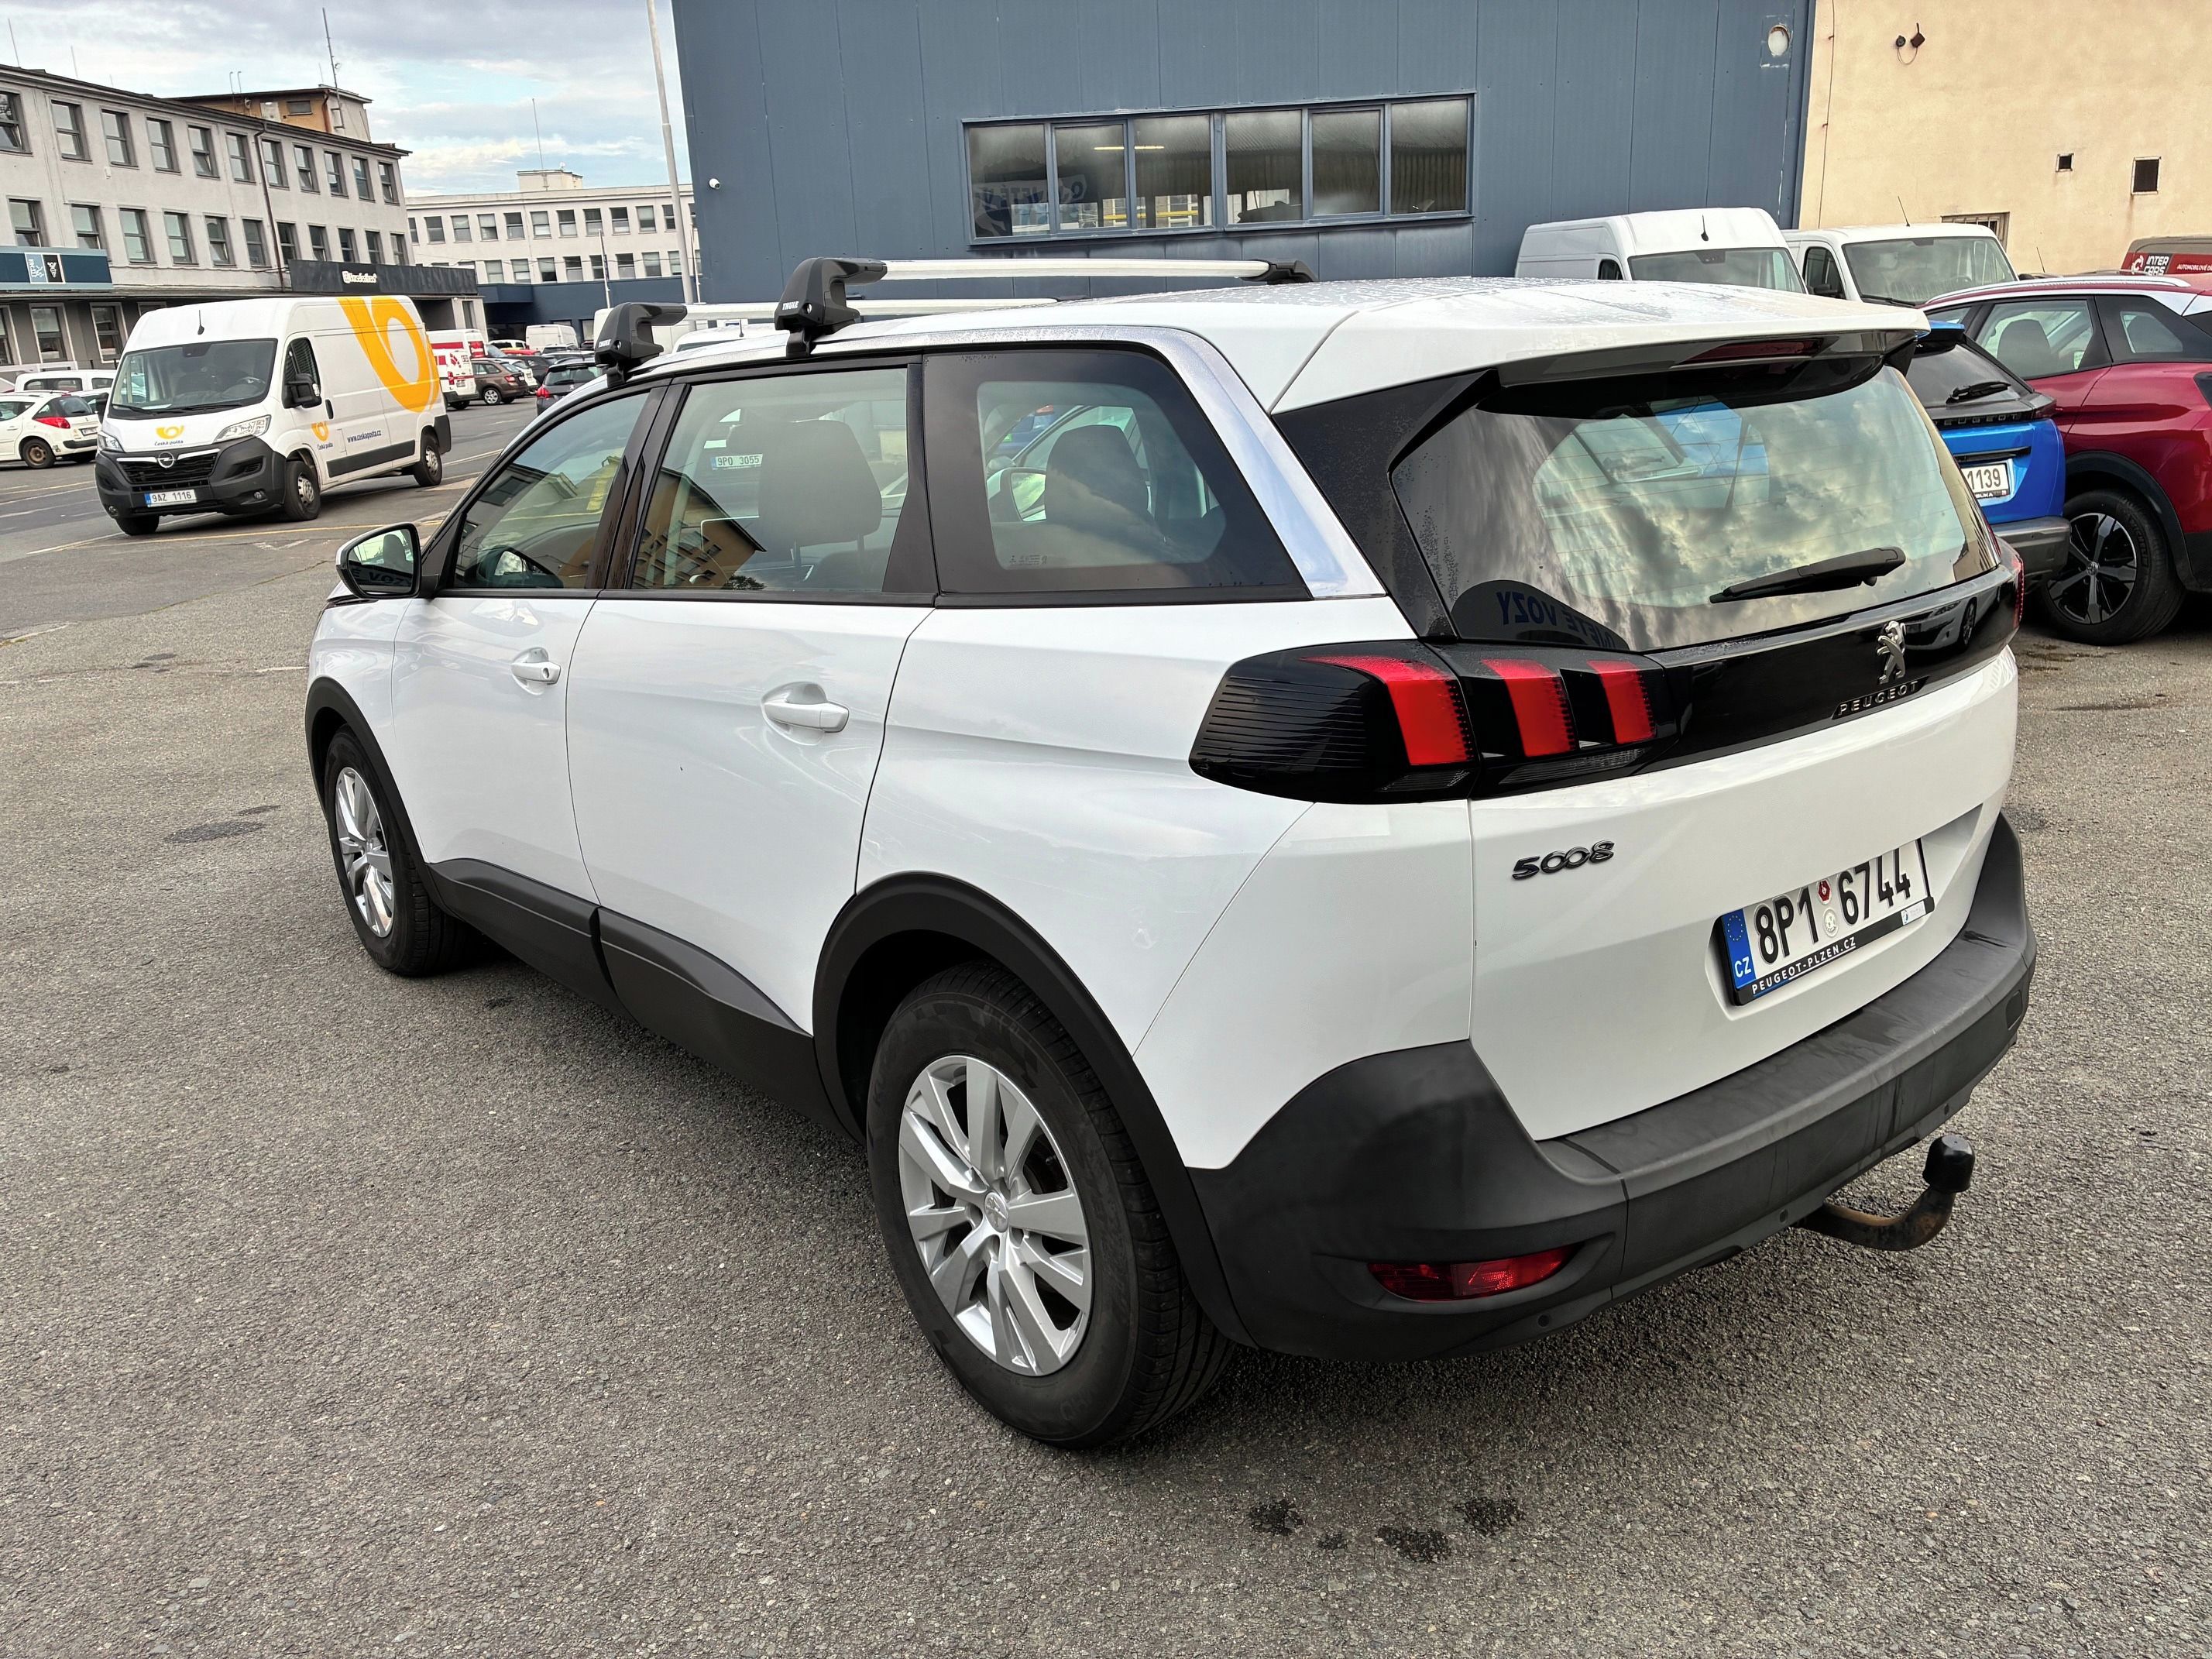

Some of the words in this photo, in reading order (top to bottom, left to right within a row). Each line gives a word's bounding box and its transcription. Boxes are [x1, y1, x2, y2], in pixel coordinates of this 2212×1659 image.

[2144, 266, 2166, 276] CARS
[2146, 256, 2169, 266] INTER
[782, 301, 799, 310] THULE
[739, 455, 760, 465] 3055
[1967, 468, 2001, 489] 1139
[1838, 681, 1918, 716] PEUGEOT
[1512, 840, 1615, 880] 5008
[1754, 888, 1819, 964] 8P1
[1838, 847, 1911, 925] 6744
[1734, 957, 1751, 978] CZ
[1752, 936, 1856, 994] PEUGEOT-PLZEN.CZ
